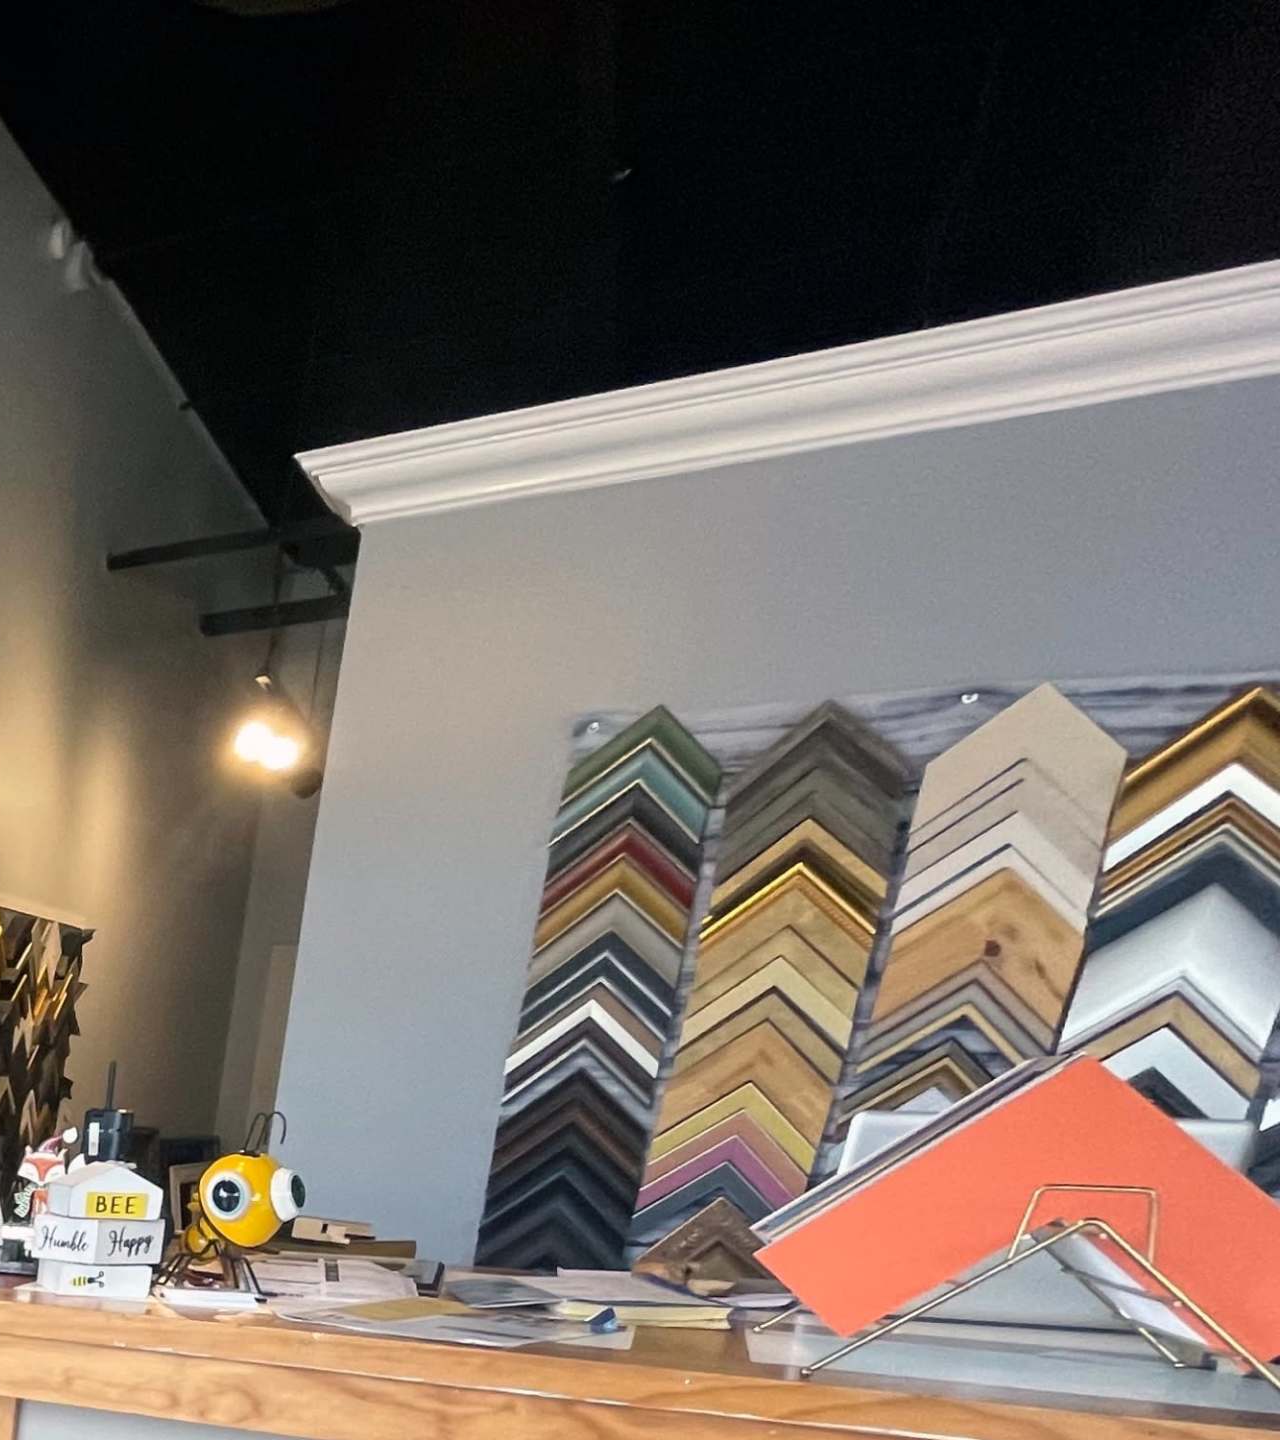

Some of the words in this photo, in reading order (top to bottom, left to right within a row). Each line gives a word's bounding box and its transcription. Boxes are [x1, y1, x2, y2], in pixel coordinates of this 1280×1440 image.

[95, 1195, 137, 1214] BEE
[38, 1225, 88, 1252] Humble
[107, 1225, 154, 1258] Happy
